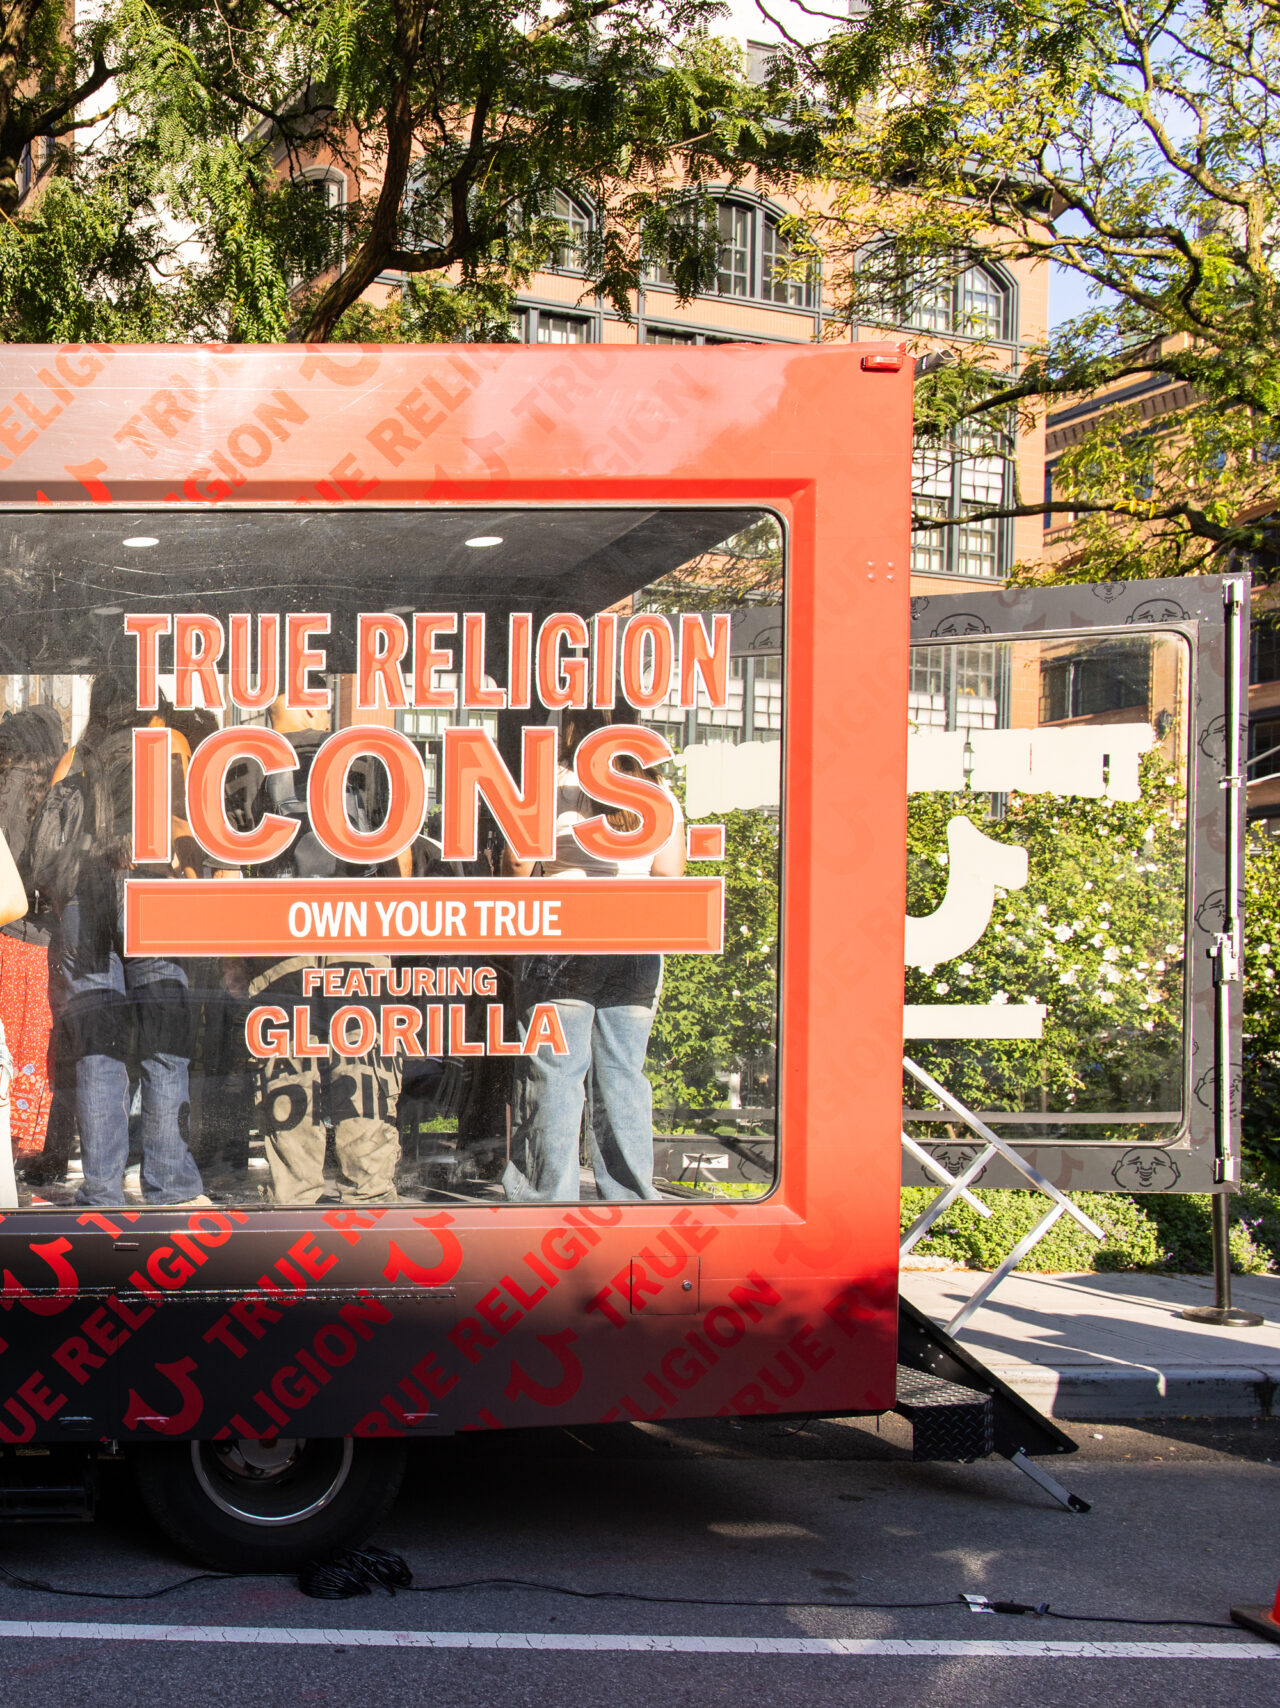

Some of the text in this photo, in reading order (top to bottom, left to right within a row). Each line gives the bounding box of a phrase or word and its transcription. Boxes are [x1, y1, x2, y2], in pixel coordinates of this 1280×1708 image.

[163, 386, 310, 503] GION
[125, 612, 331, 711] TRUE
[357, 612, 732, 711] RELIGION
[131, 725, 725, 863] ICONS.
[288, 900, 562, 937] OWN YOUR TRUE
[245, 1003, 570, 1058] GLORILLA
[303, 967, 497, 997] FEATURING
[202, 1231, 339, 1359] TRUE
[585, 1210, 718, 1330] TRUE
